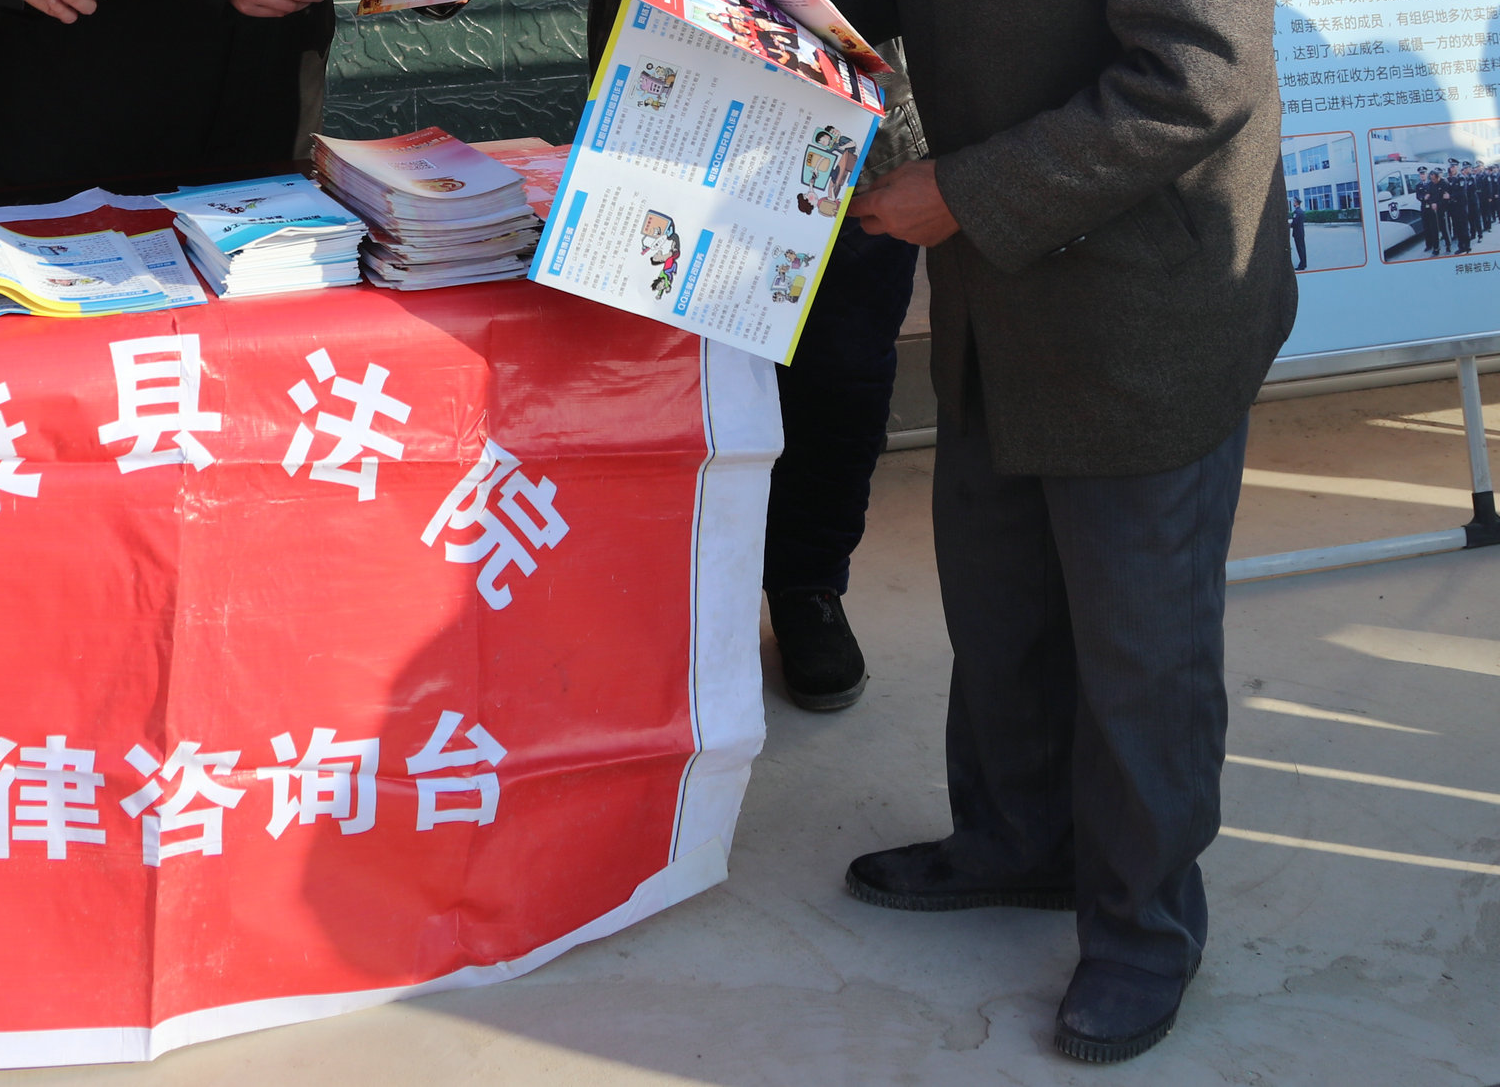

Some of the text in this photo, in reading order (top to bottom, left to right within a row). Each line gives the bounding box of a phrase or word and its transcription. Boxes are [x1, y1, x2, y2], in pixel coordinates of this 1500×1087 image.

[1273, 6, 1500, 35] 、姻亲关系的成员,有组织地多次实施
